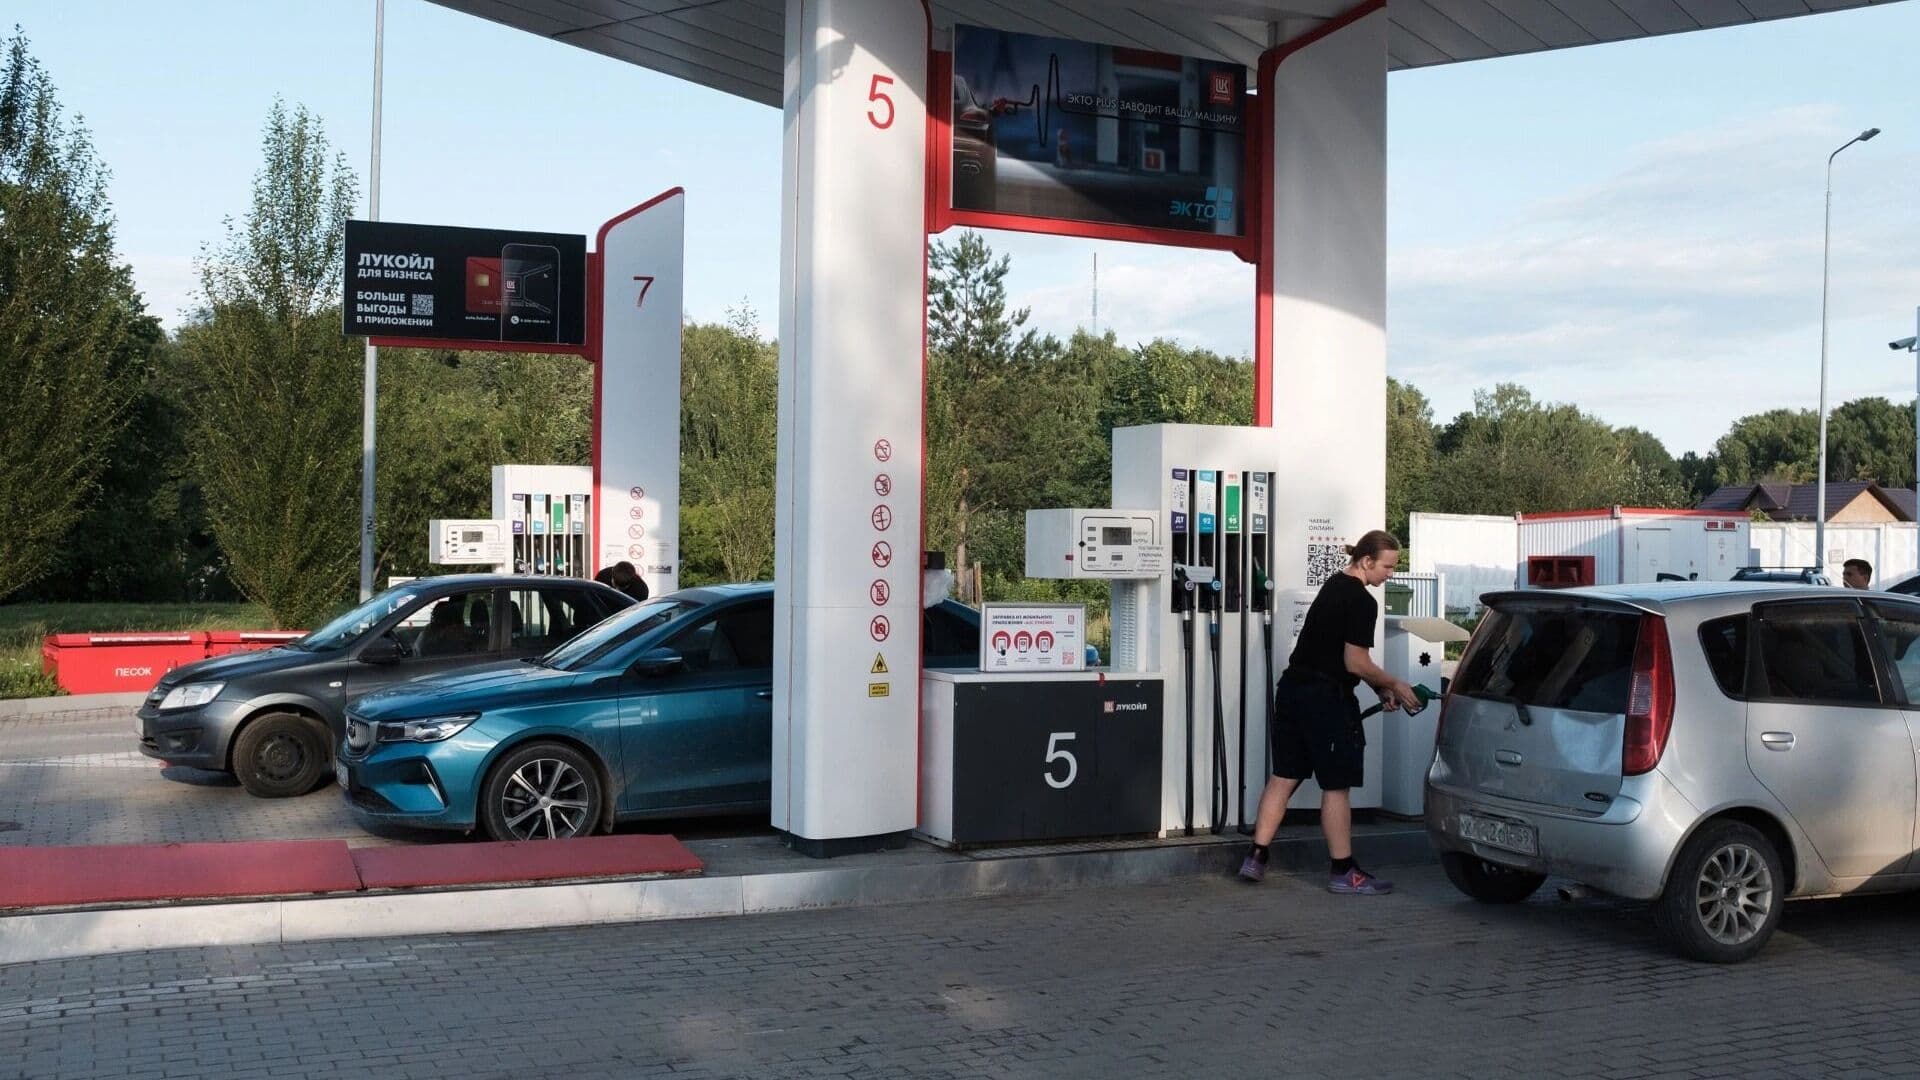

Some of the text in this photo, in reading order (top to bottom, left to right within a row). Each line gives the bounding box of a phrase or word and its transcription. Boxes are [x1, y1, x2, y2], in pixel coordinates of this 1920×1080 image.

[867, 74, 895, 130] 5
[1068, 93, 1237, 124] ЭКТО PLUS ЗАВОДИТ ВАШУ МАШИНУ
[1168, 200, 1217, 218] ЭКТО
[357, 252, 435, 270] ЛУКОЙЛ
[357, 268, 433, 281] ДЛЯ БИЗНЕСА
[357, 291, 406, 302] БОЛЬШЕ
[633, 276, 654, 308] 7
[356, 303, 407, 316] ВЫГОДЫ
[356, 315, 433, 327] В ПРИЛОЖЕНИИ
[115, 667, 152, 677] ПЕСОК
[1115, 702, 1148, 711] ЛУКОЙЛ
[1044, 732, 1078, 789] 5
